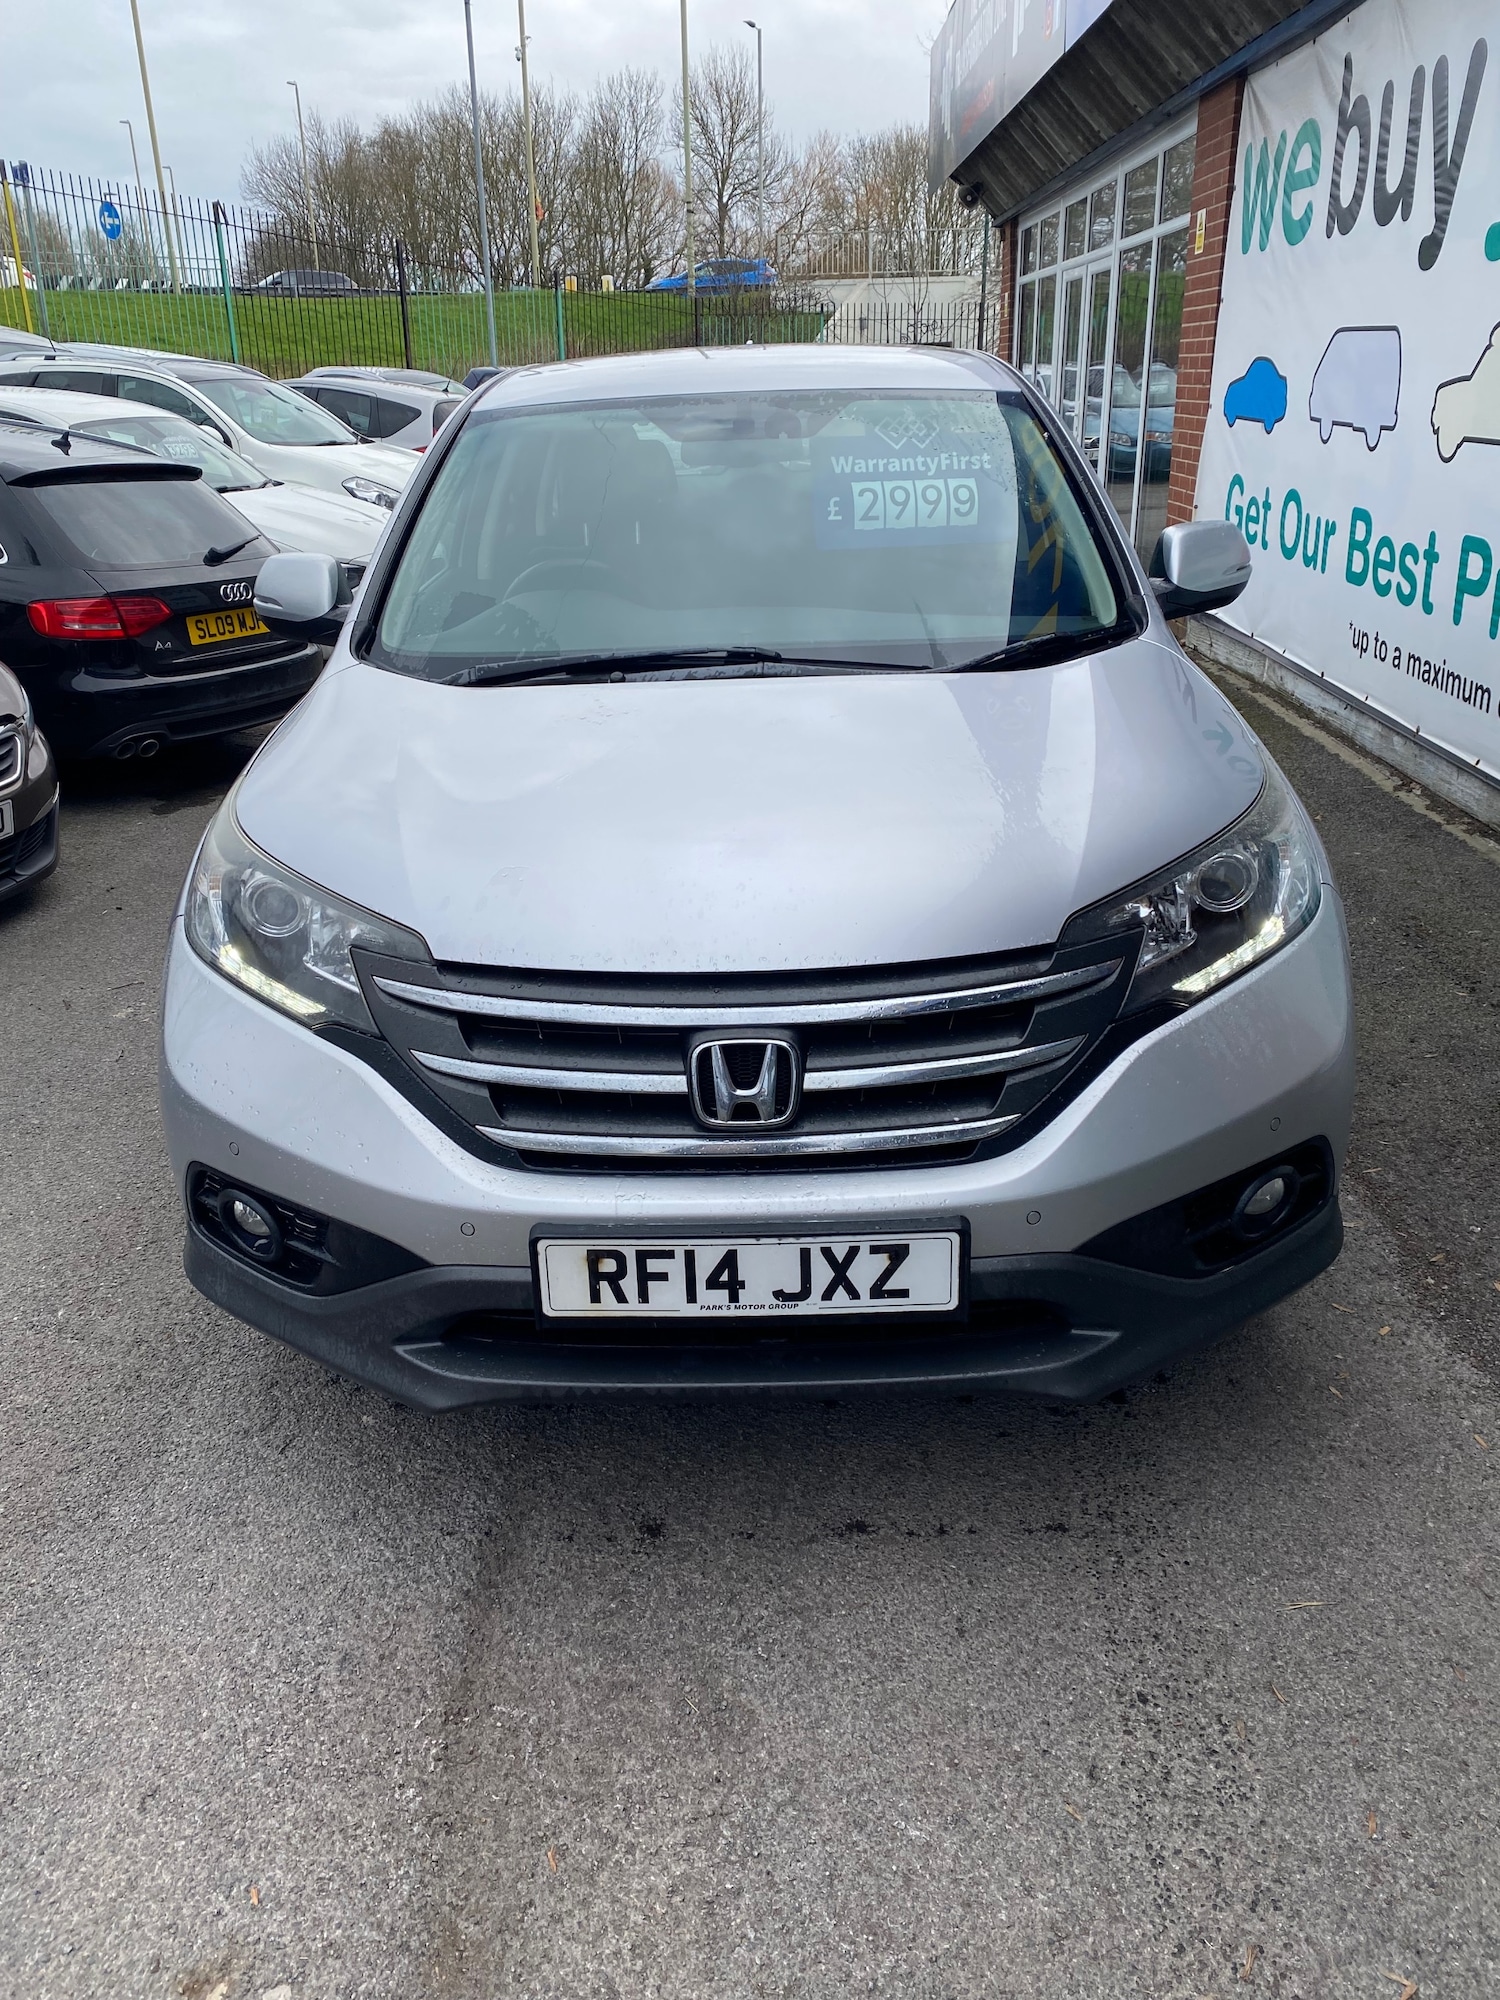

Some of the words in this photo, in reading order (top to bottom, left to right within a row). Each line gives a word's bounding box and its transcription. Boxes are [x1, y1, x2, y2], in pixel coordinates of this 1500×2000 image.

[831, 452, 992, 476] WarrantyFirst
[827, 497, 842, 520] £
[857, 484, 976, 522] 2999
[1225, 473, 1271, 550] Get
[1279, 488, 1337, 574] Our
[1345, 506, 1440, 615] Best
[195, 614, 235, 640] SL09
[236, 609, 260, 633] MJ
[154, 640, 172, 652] A4
[1374, 631, 1389, 663] to
[1392, 646, 1402, 670] a
[1406, 651, 1492, 714] maximum
[587, 1249, 746, 1304] RF14
[772, 1243, 910, 1301] JXZ
